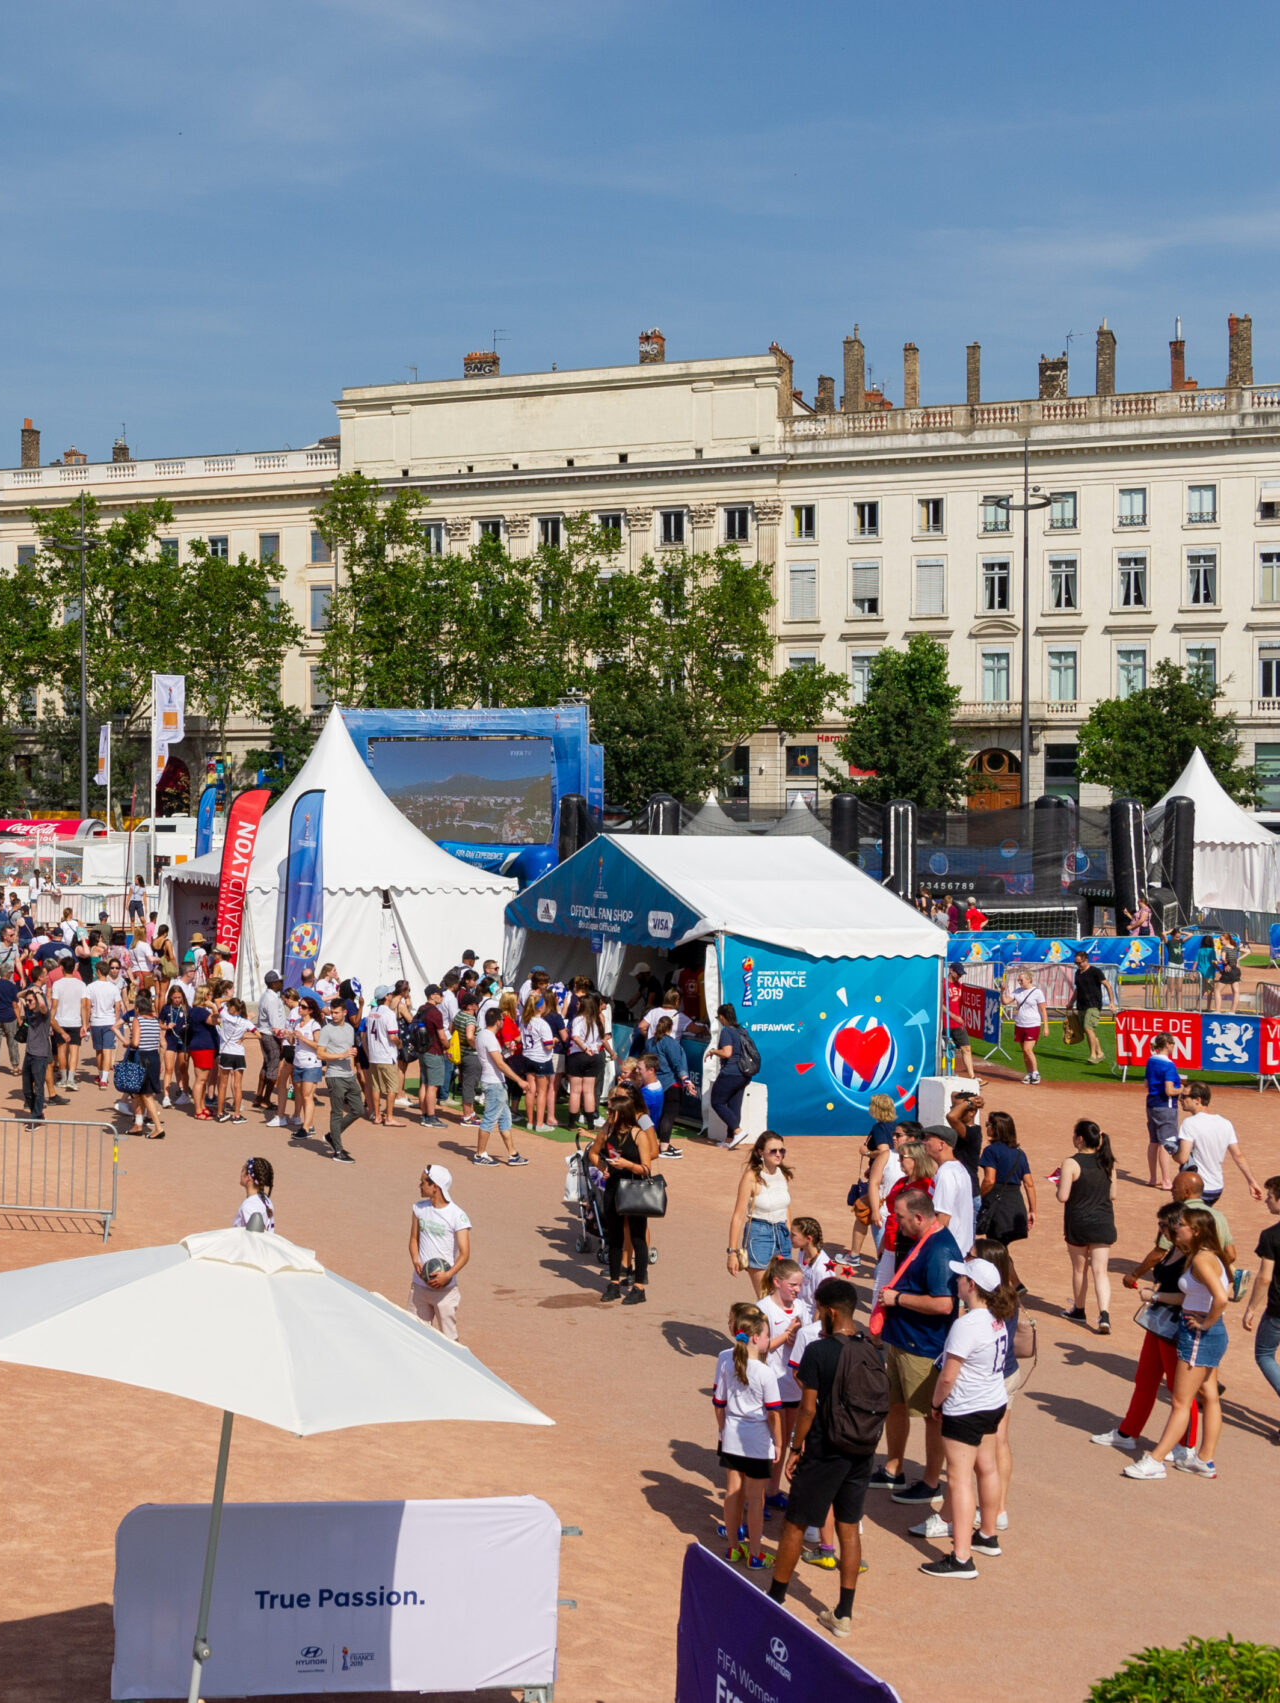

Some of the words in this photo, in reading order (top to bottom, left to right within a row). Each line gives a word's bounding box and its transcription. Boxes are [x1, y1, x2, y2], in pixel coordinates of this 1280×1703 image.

[6, 823, 61, 834] Coca-Cola
[570, 904, 597, 919] OFFICIAL
[599, 907, 612, 921] FAN
[613, 909, 633, 922] SHOP
[652, 918, 669, 931] VISA
[757, 976, 807, 988] FRANCE
[757, 988, 784, 1000] 2019
[751, 1023, 795, 1031] #FIFAWWC
[961, 1005, 981, 1031] YON
[1115, 1017, 1163, 1033] VILLE
[1169, 1019, 1192, 1034] DE
[371, 1020, 377, 1041] 4
[1117, 1034, 1192, 1061] LYN
[1266, 1042, 1280, 1066] L
[255, 1590, 311, 1610] True
[319, 1586, 425, 1608] Passion.
[295, 1658, 327, 1666] HYUNDAI
[717, 1647, 737, 1680] FIFA
[765, 1653, 792, 1682] HYUNDAI
